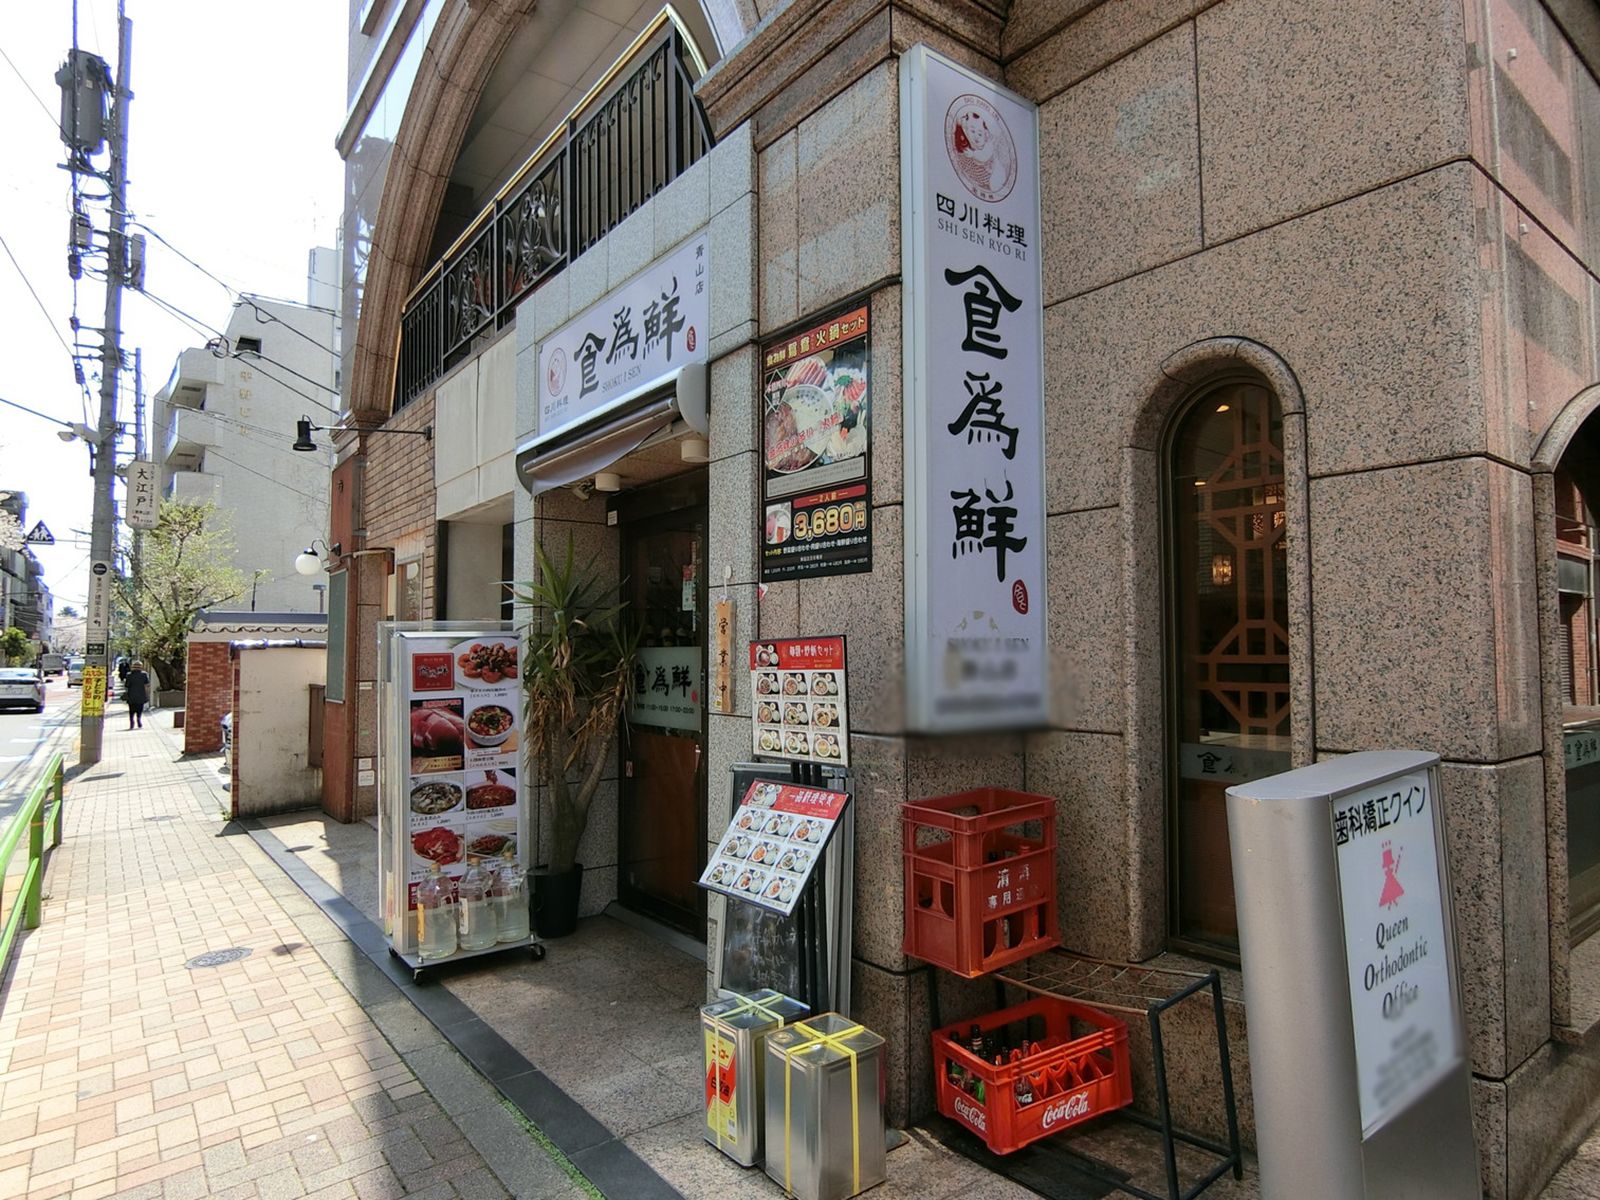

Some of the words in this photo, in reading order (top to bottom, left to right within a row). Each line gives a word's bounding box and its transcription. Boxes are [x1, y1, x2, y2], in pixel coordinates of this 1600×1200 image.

[937, 192, 1028, 249] 四川料理
[937, 217, 958, 236] SHI
[962, 227, 985, 246] SEN
[989, 237, 1011, 256] RYO
[1015, 248, 1026, 262] RI
[695, 244, 704, 295] 青山店
[136, 467, 149, 507] 大江戸
[794, 503, 867, 541] 3,680円
[1335, 786, 1426, 846] 歯科矯正クイン
[1376, 917, 1409, 950] Queen
[1364, 936, 1428, 991] Orthodontic
